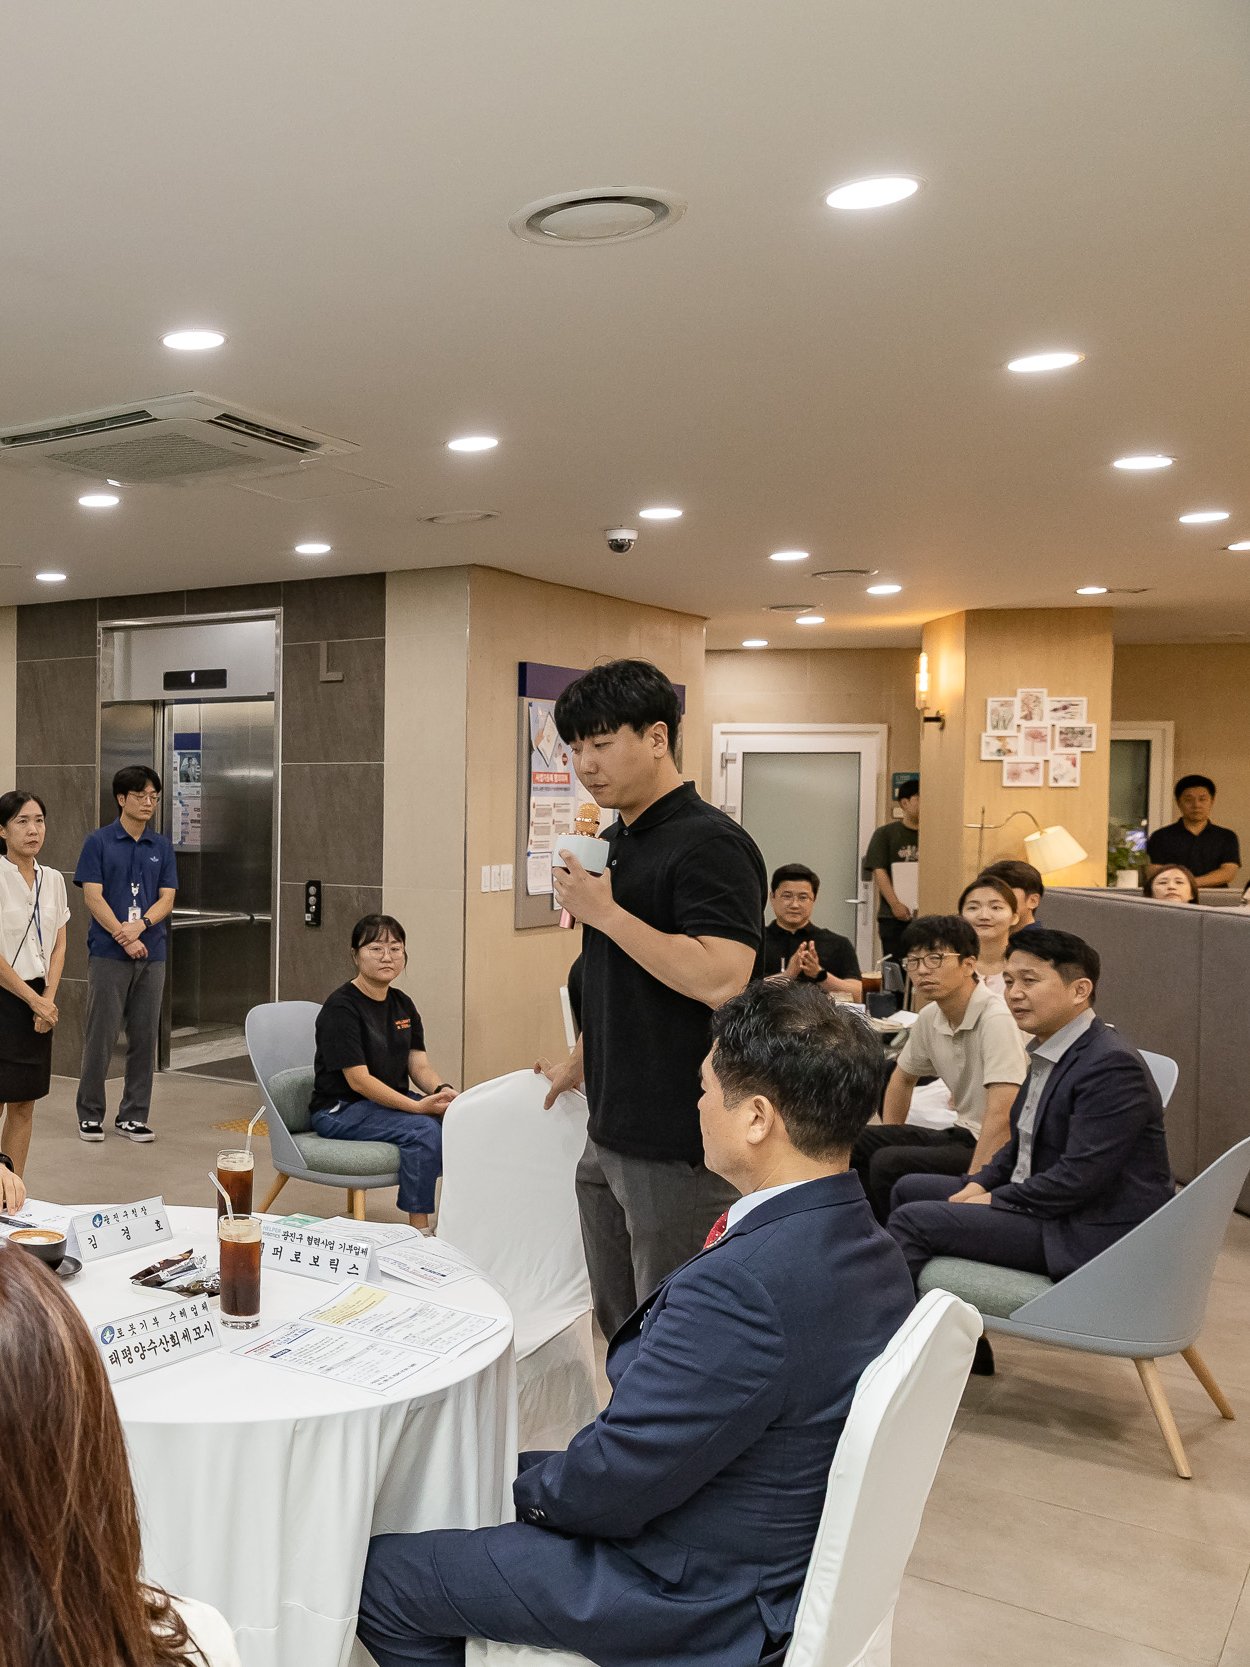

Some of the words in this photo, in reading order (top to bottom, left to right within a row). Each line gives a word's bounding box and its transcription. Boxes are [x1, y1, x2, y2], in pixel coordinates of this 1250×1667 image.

[281, 1230, 304, 1244] 광진구
[306, 1235, 336, 1251] 협력사업
[338, 1242, 369, 1258] 기부업체
[116, 1316, 160, 1339] 로봇기부
